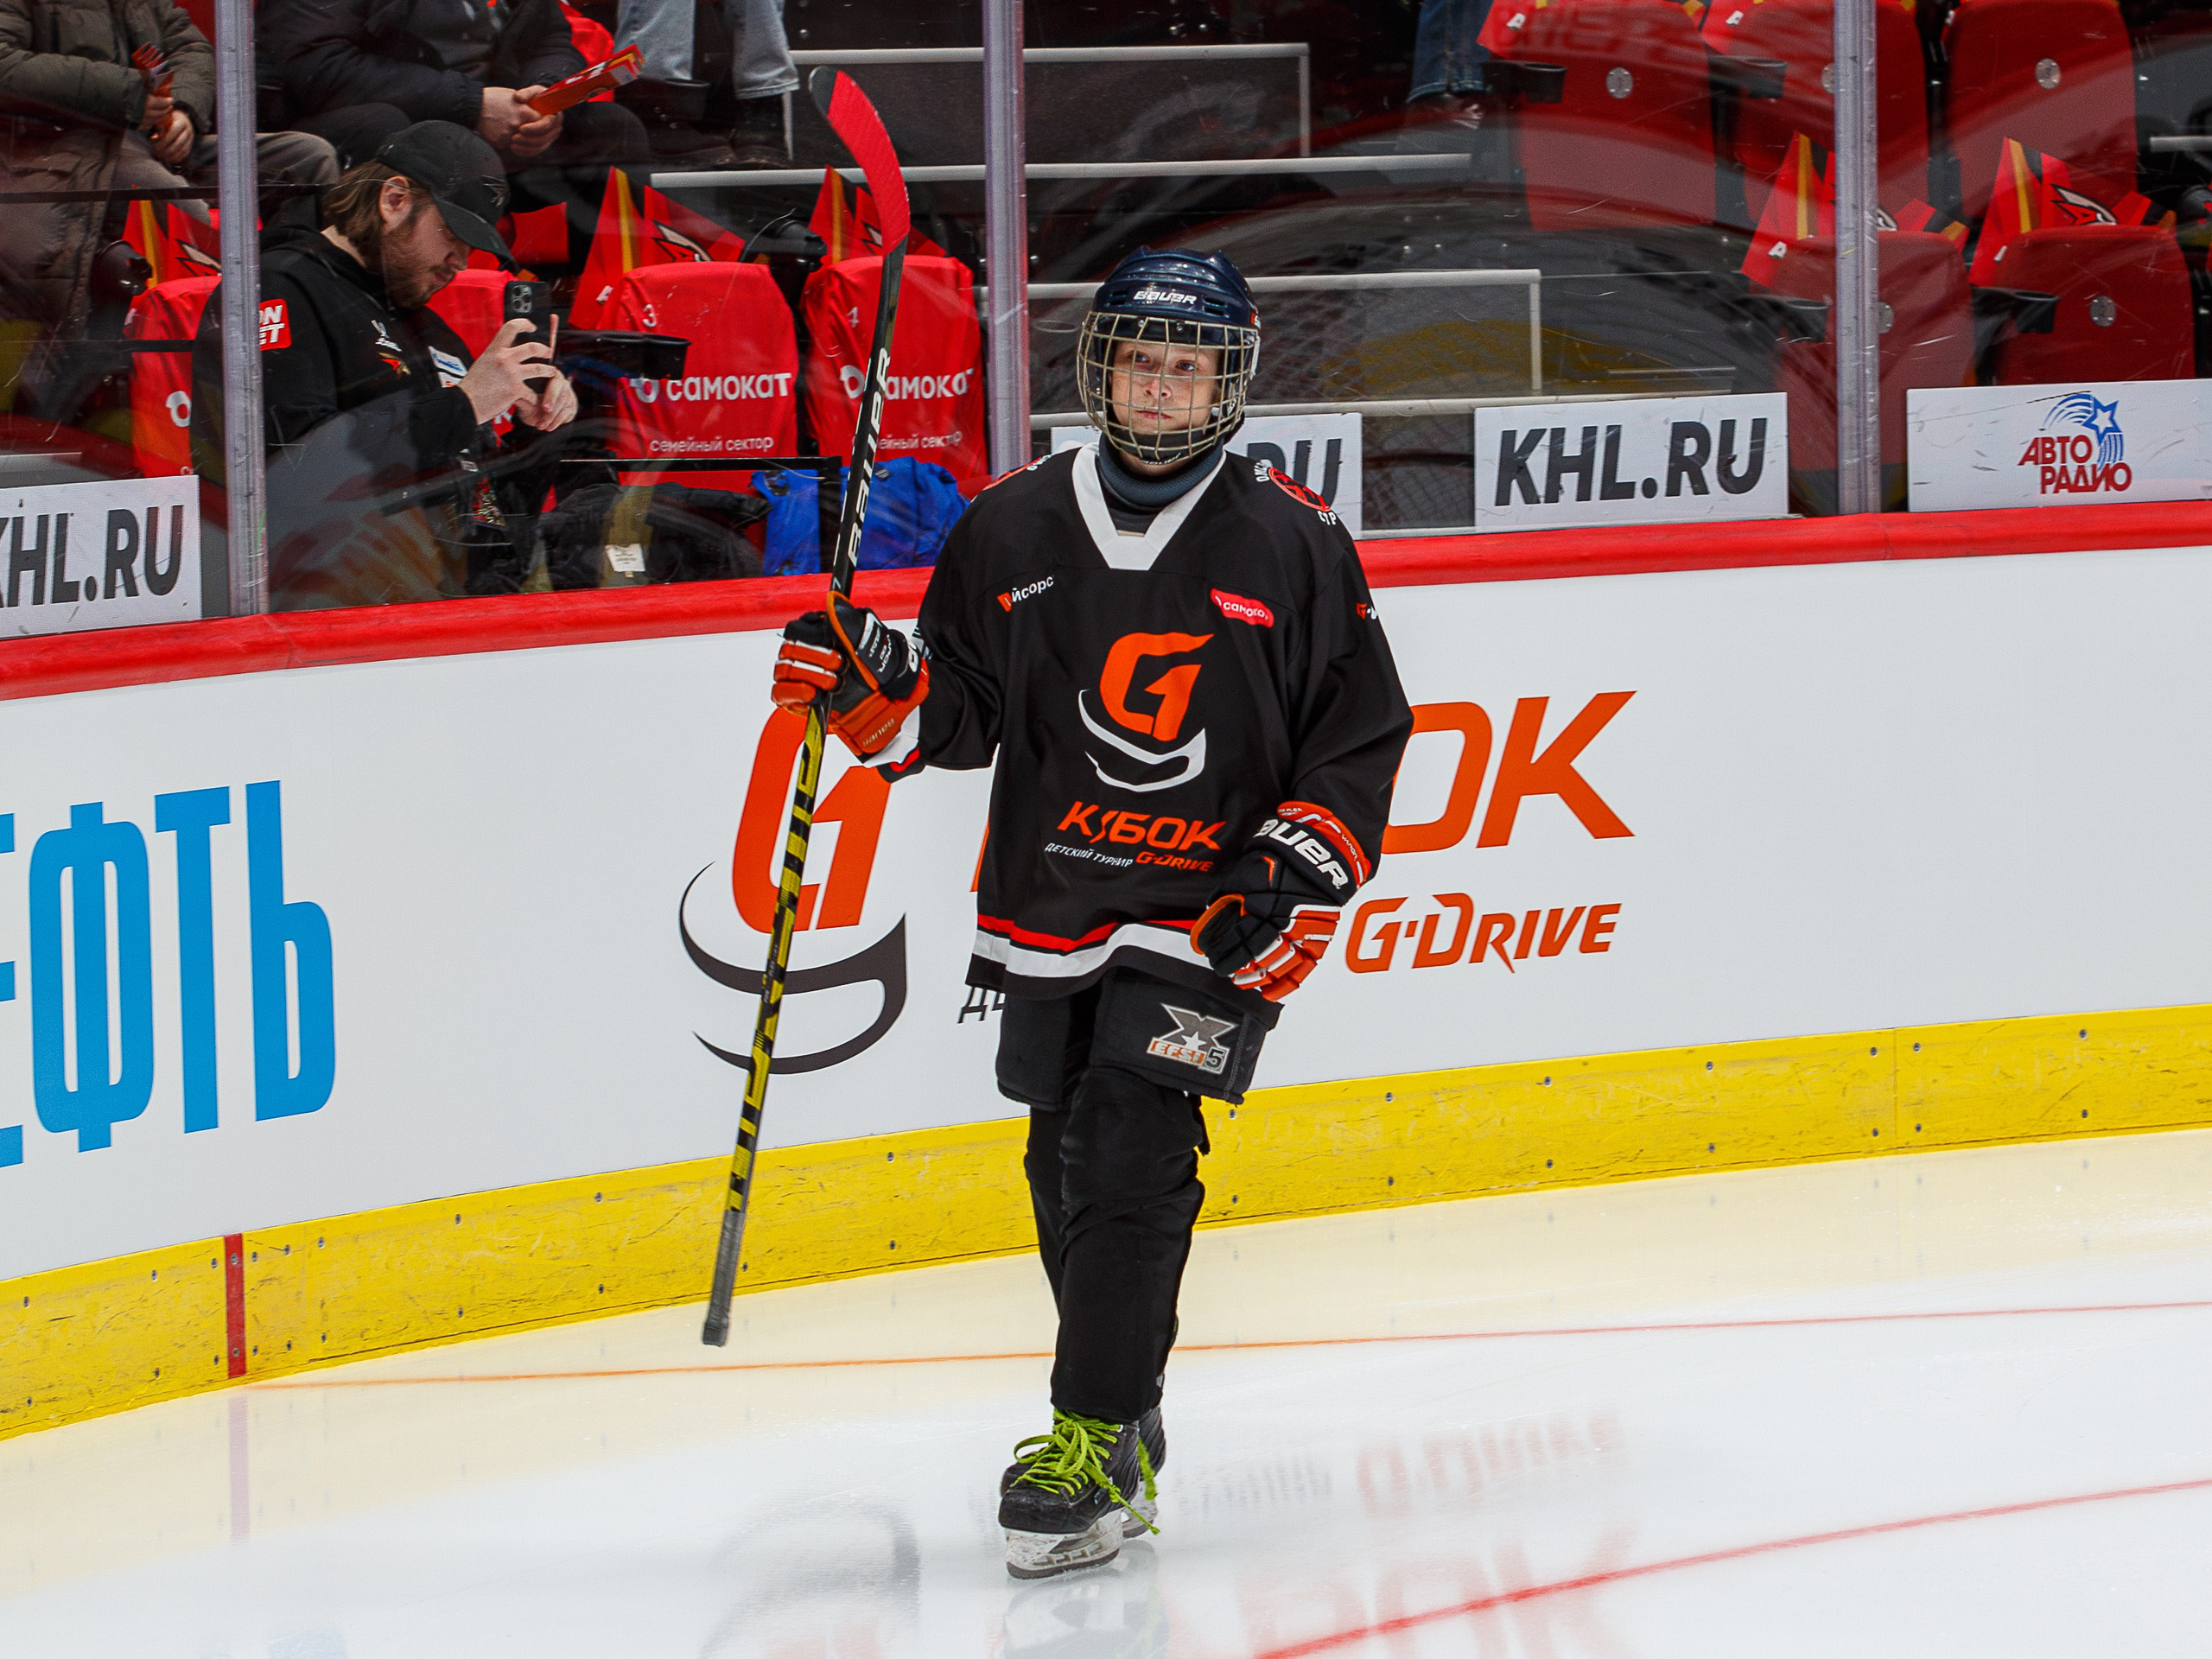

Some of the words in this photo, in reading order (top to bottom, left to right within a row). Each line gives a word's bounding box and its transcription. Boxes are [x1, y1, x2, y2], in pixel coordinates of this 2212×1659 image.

[1134, 290, 1198, 305] BAUER
[643, 304, 658, 327] 3
[666, 372, 792, 401] самокат
[885, 367, 975, 400] амока
[650, 435, 722, 452] семейный
[725, 436, 774, 452] сектор
[2018, 435, 2093, 466] АВТО
[1495, 418, 1768, 506] KHL.RU
[2040, 462, 2133, 494] РАДИО
[0, 505, 184, 608] HL.RU
[1045, 842, 1095, 860] ДЕТСКИЙ
[1253, 818, 1349, 889] AUER
[0, 779, 337, 1167] ФТЬ
